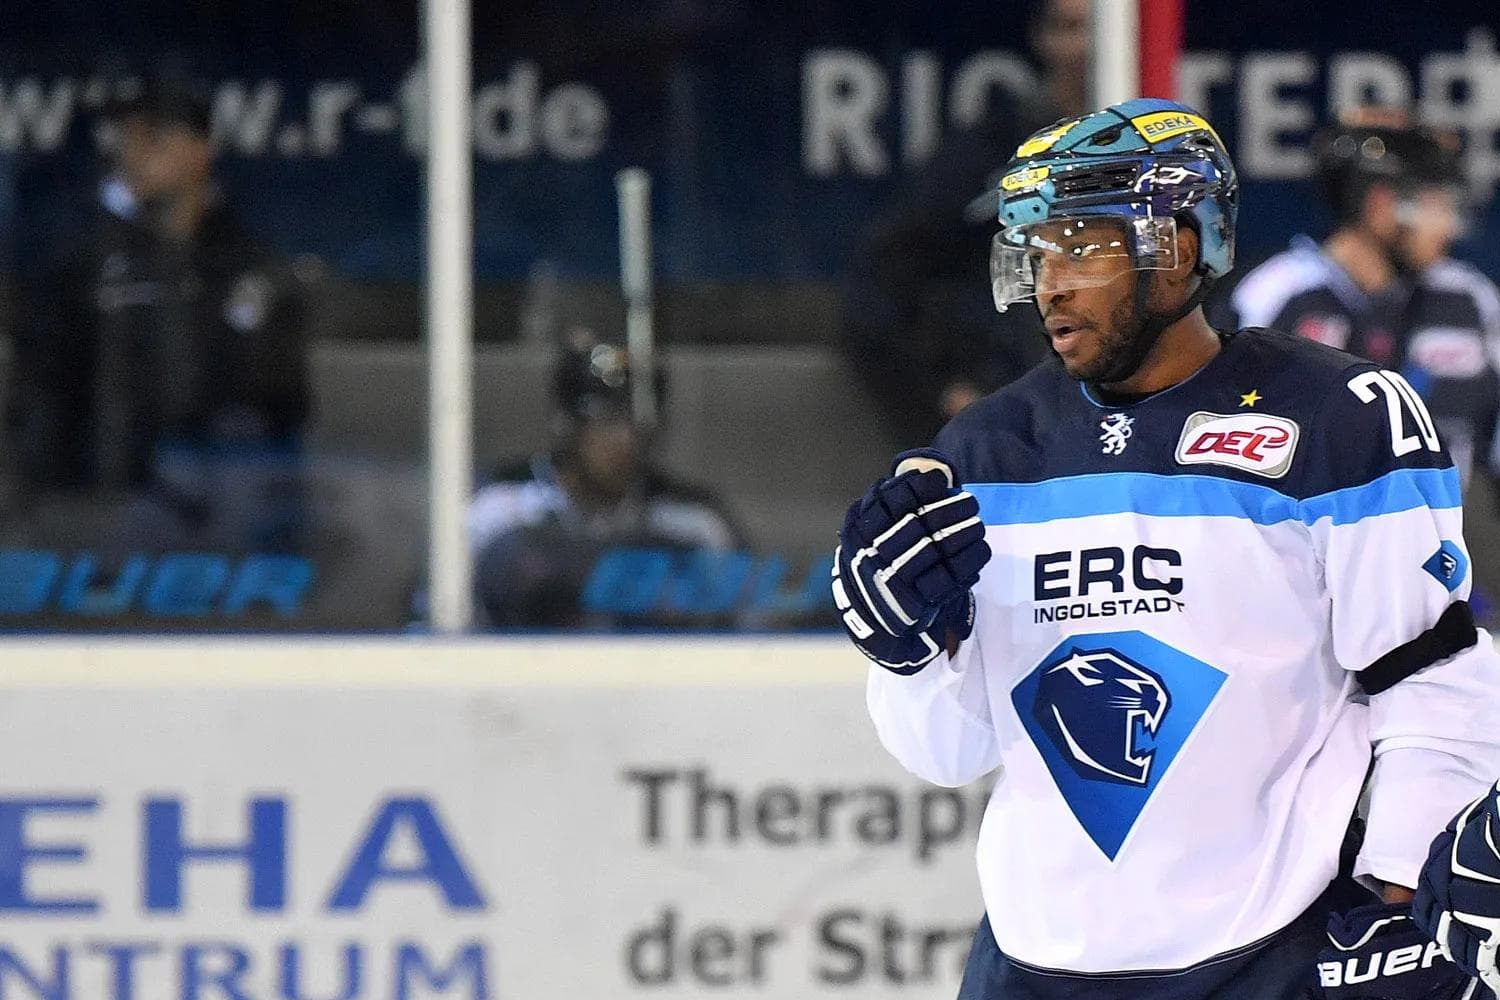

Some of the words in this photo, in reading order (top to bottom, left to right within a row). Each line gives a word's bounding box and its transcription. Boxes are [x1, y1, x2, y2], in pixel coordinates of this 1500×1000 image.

[1143, 115, 1195, 136] EDEKA
[1184, 425, 1290, 462] DEL
[1034, 545, 1184, 601] ERC
[617, 765, 992, 865] Therap
[0, 793, 491, 915] EHA
[622, 905, 790, 988] der
[814, 908, 978, 988] Str
